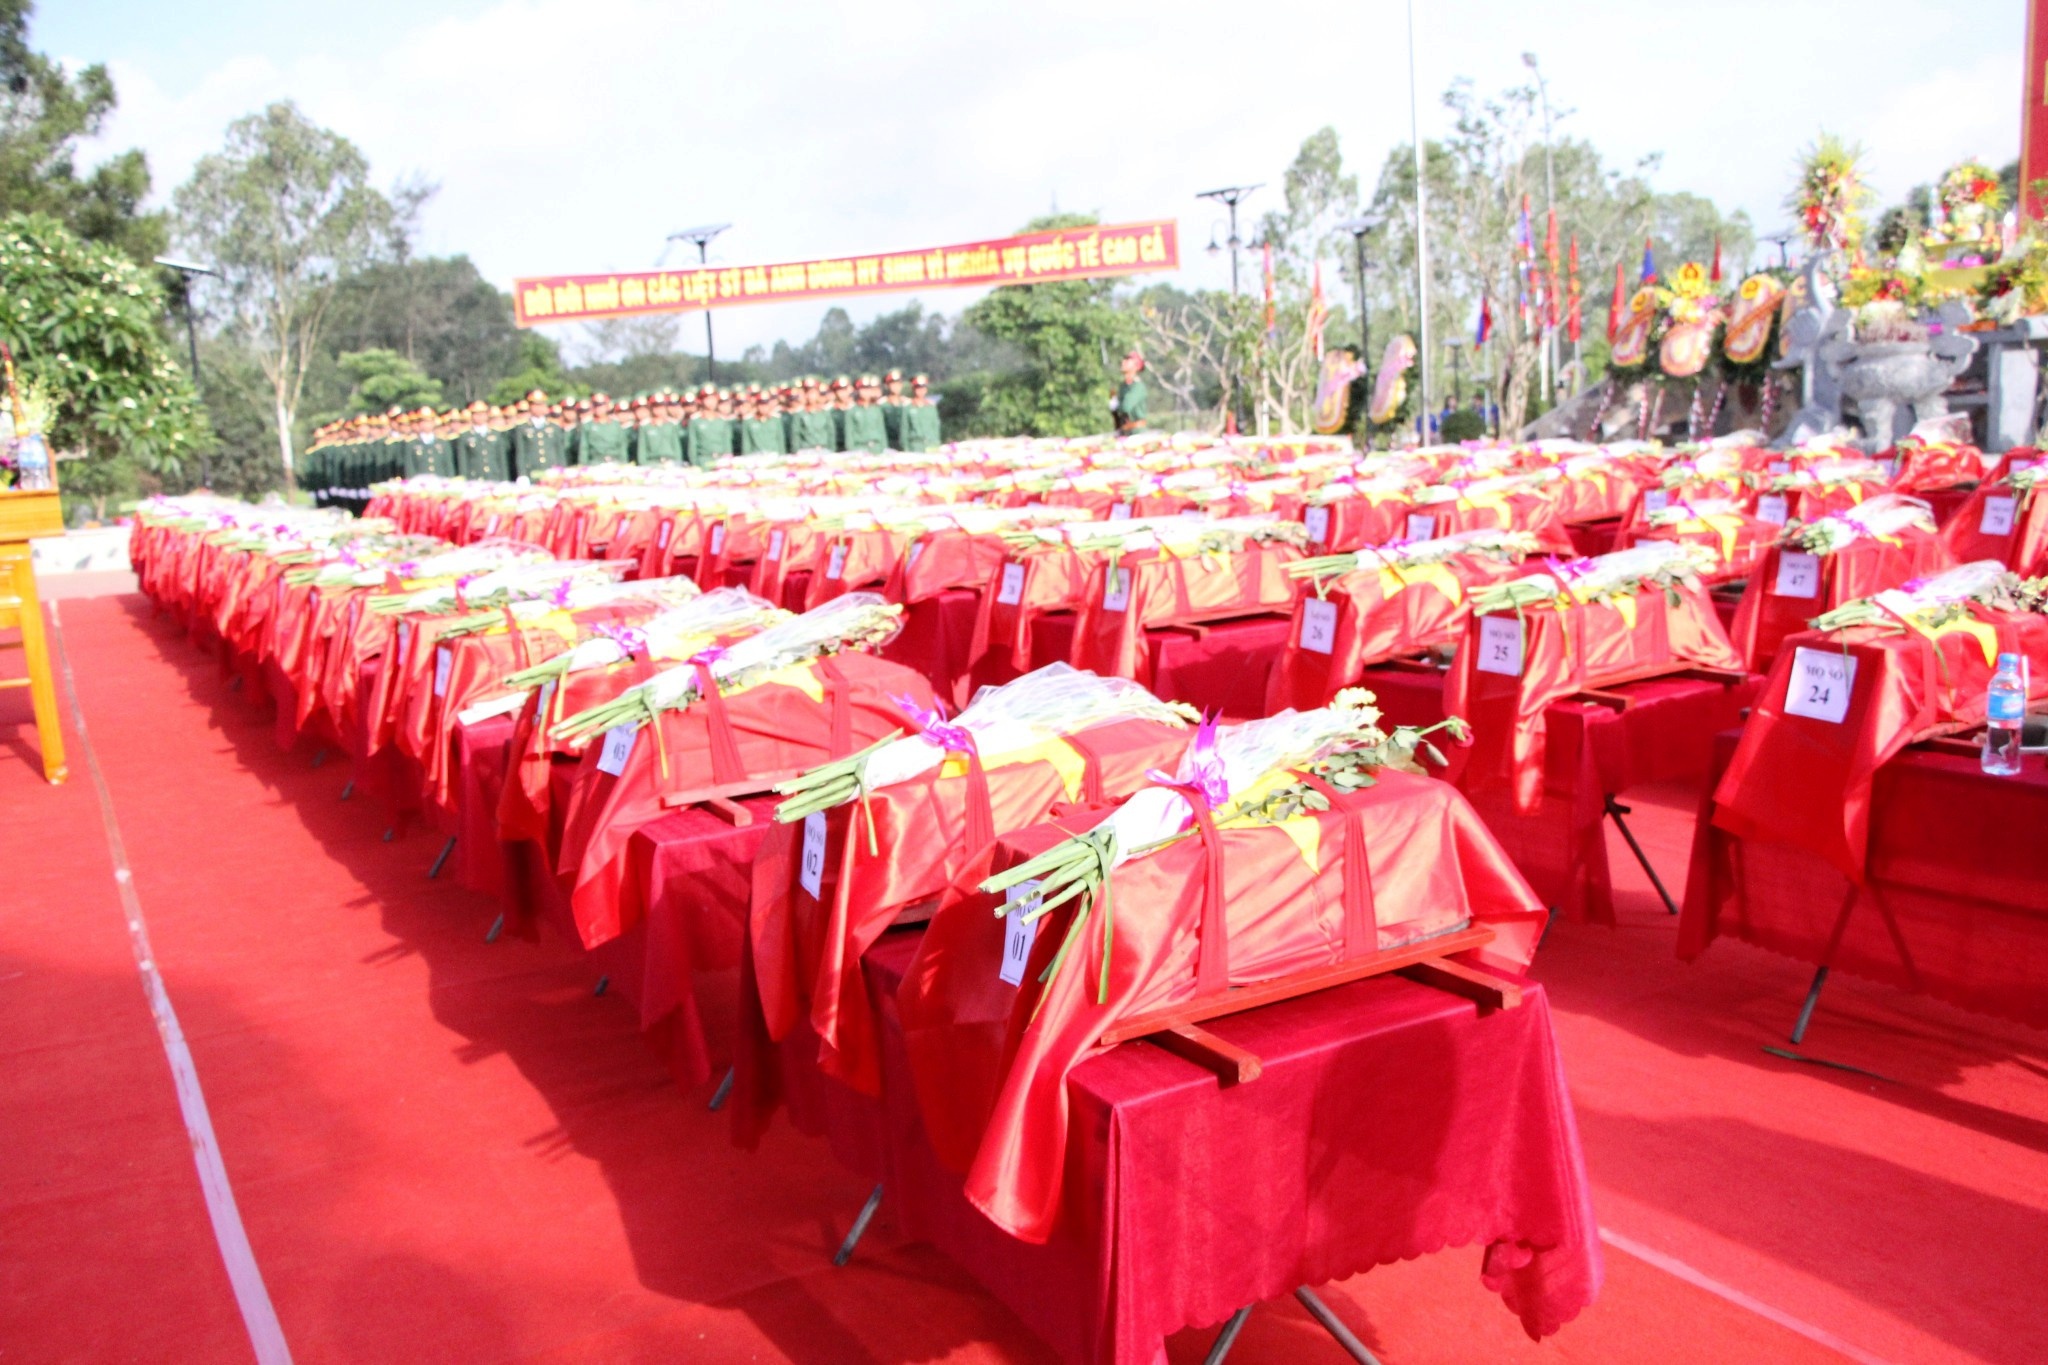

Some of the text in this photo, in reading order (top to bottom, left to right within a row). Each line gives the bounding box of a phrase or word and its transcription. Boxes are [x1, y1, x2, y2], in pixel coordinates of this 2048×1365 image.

[647, 273, 681, 304] CÁC
[683, 270, 716, 305] LIỆT
[856, 259, 878, 285] HY
[882, 255, 924, 283] SINH
[946, 246, 999, 278] NGHĨA
[1003, 247, 1025, 279] VỤ
[1028, 236, 1075, 274] QUỐC
[1077, 231, 1099, 267] TẾ
[1102, 235, 1137, 265] CAO
[1140, 225, 1166, 262] CẢ
[1790, 574, 1805, 587] 47
[1312, 625, 1323, 640] 26
[1493, 644, 1508, 661] 25
[1808, 684, 1830, 705] 24
[613, 742, 626, 761] 03
[806, 849, 818, 876] 02
[1012, 931, 1026, 961] 01
